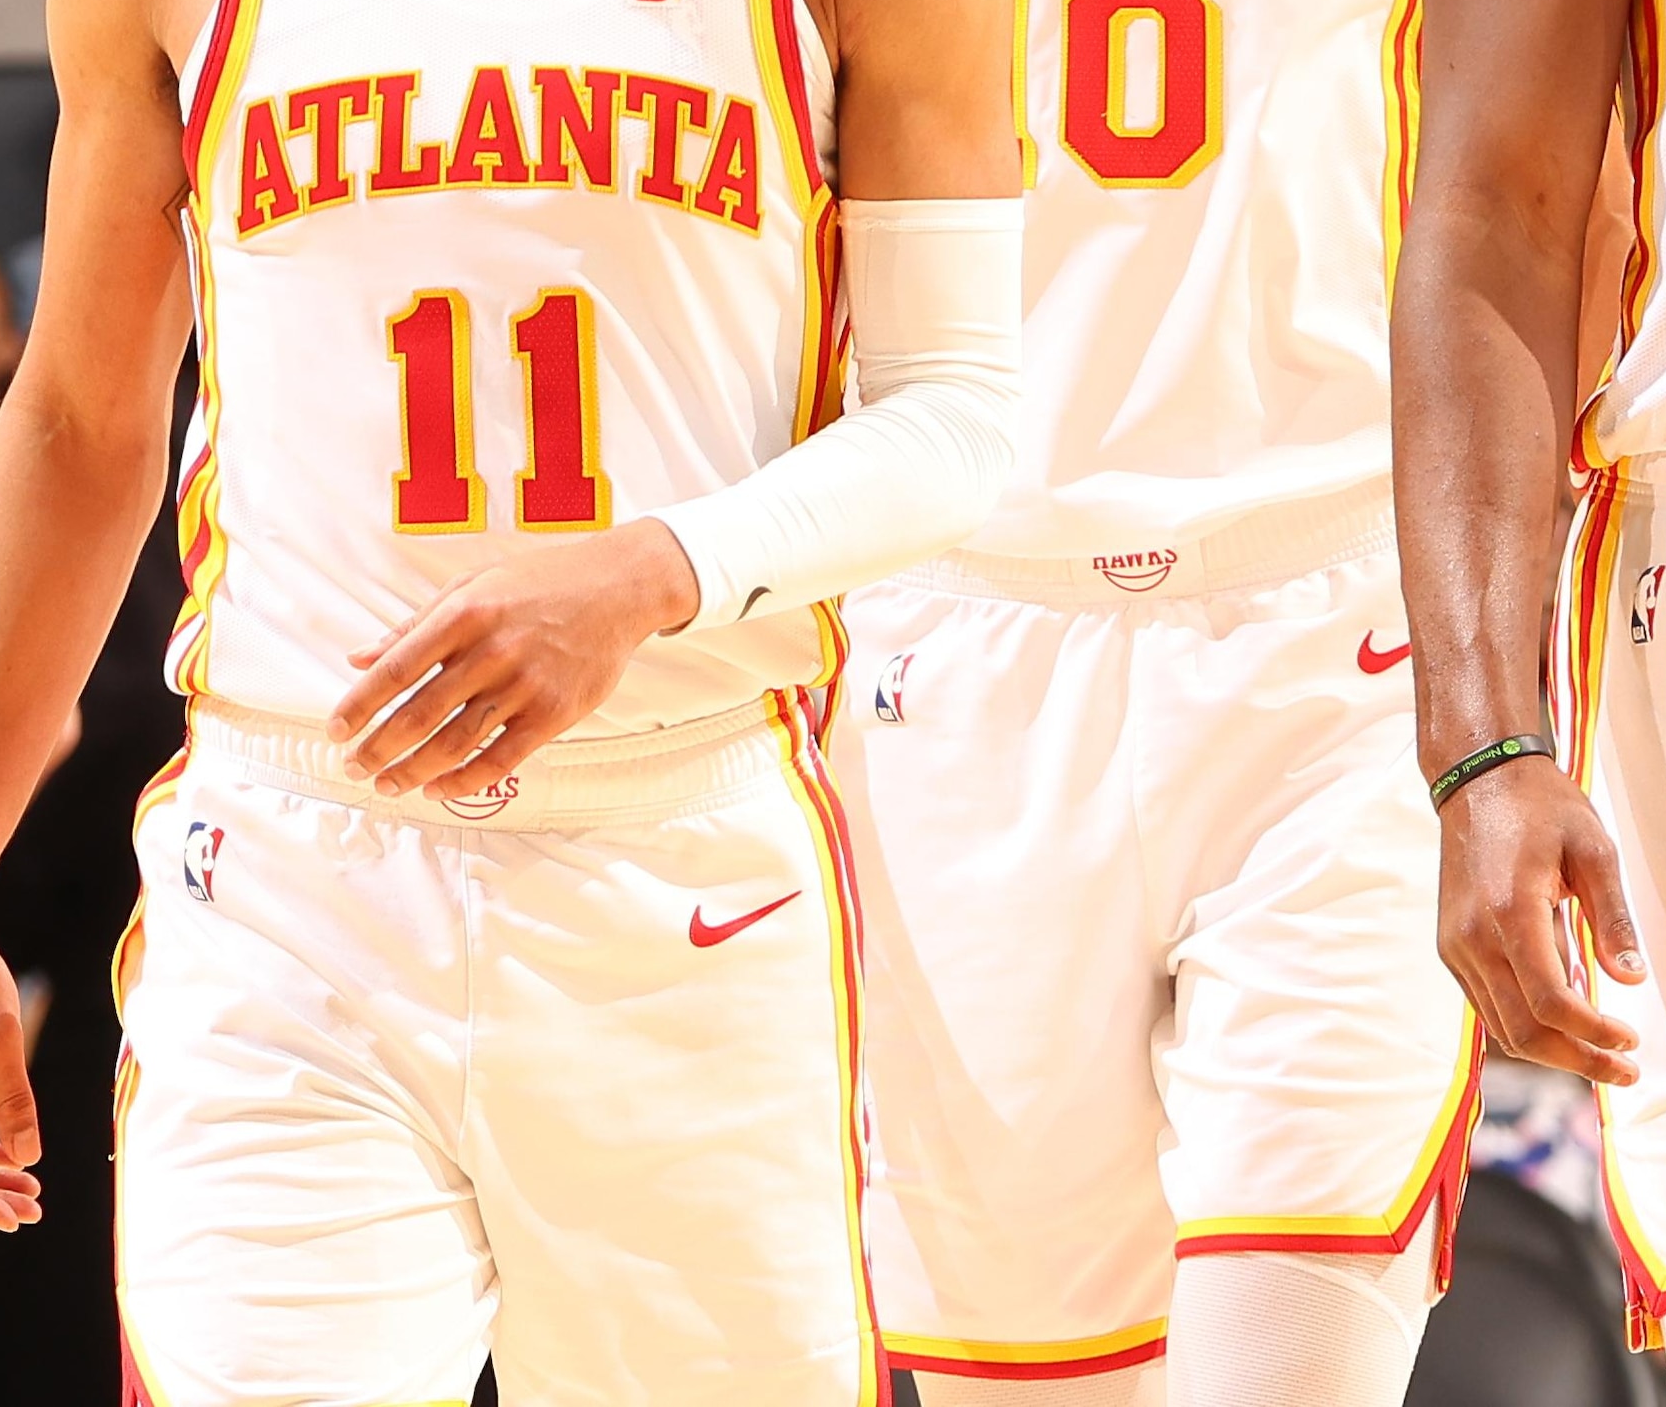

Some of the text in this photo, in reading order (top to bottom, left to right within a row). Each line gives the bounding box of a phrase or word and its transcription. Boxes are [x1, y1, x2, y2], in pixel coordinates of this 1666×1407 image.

[236, 66, 765, 239] ATLANTA
[386, 287, 613, 534] 11
[1462, 746, 1502, 773] Nnamdi
